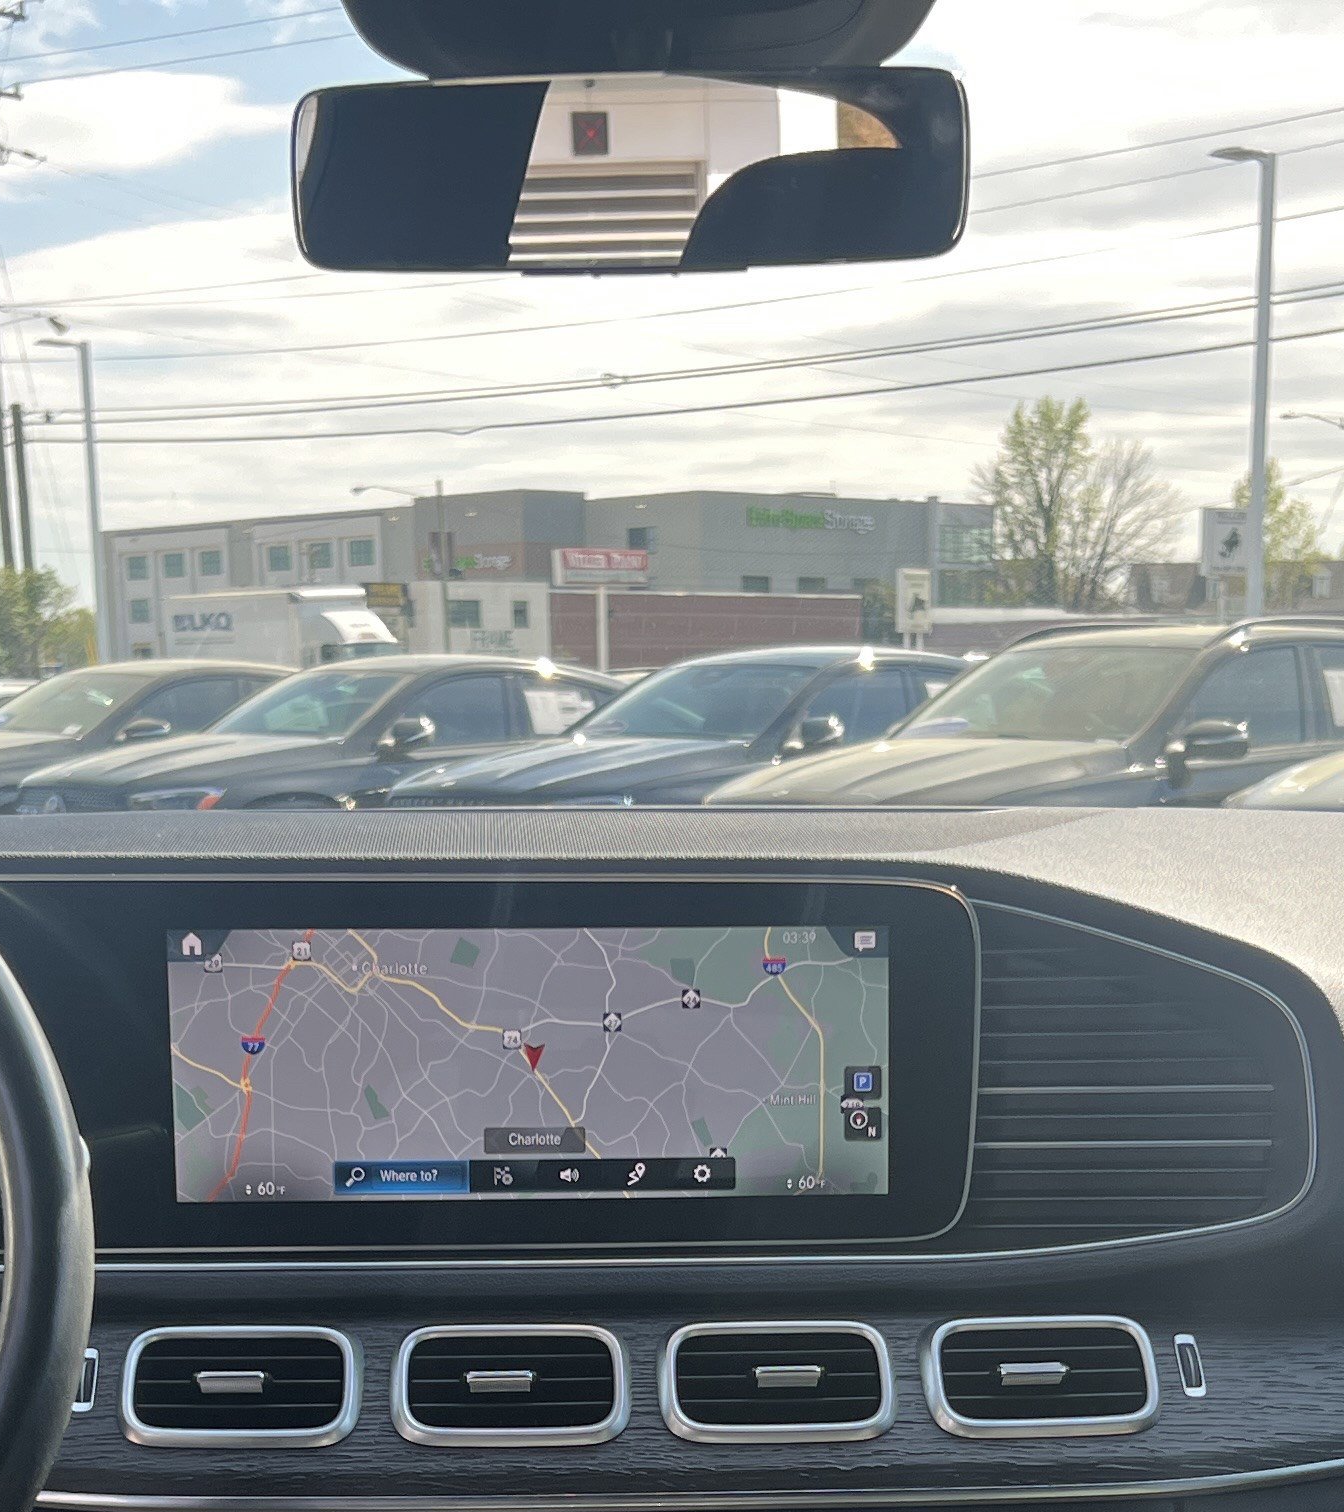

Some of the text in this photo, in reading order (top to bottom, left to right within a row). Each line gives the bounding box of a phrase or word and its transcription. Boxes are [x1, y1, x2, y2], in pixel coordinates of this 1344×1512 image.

[782, 928, 817, 945] 03:39
[296, 947, 309, 958] 21
[208, 958, 220, 969] 29
[361, 961, 428, 976] Charlotte
[765, 963, 783, 974] 485
[686, 996, 697, 1005] 24
[607, 1019, 619, 1029] 27
[507, 1035, 518, 1045] 74
[770, 1093, 817, 1106] Mint Hill
[867, 1126, 877, 1138] N
[508, 1132, 562, 1147] Charlotte
[379, 1169, 439, 1183] Where to?
